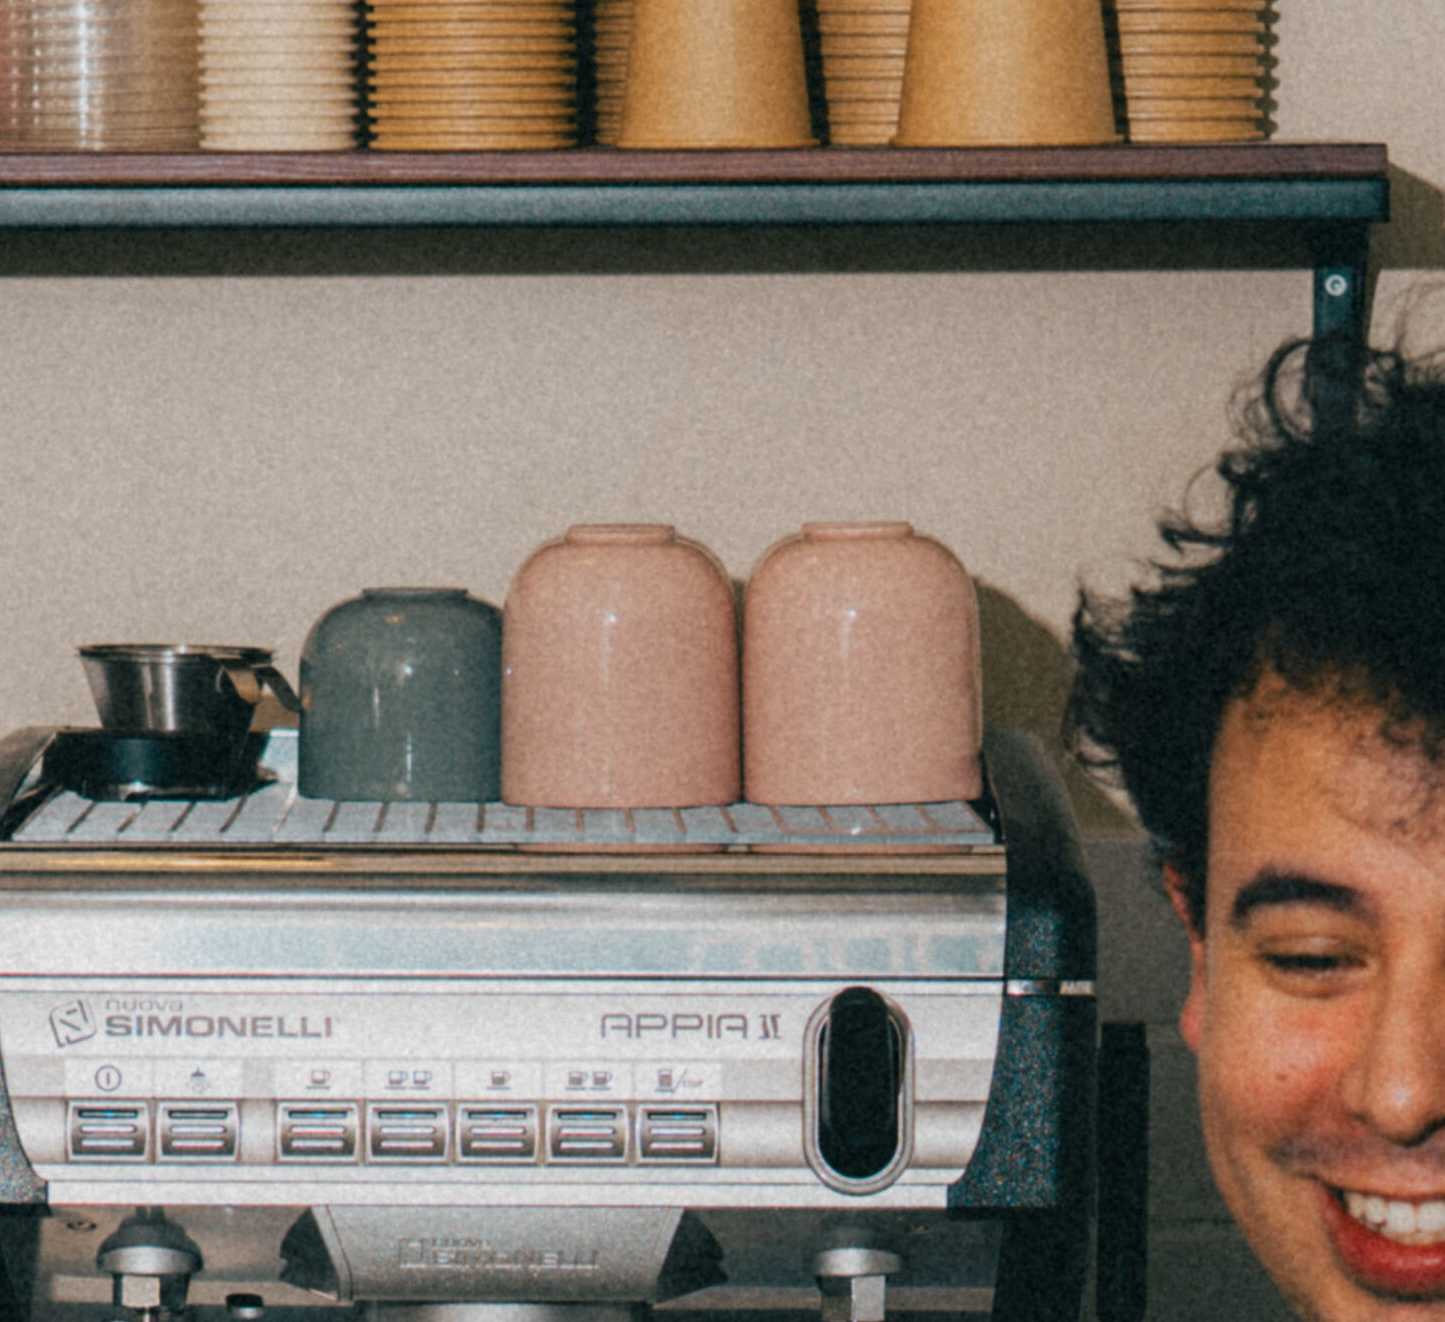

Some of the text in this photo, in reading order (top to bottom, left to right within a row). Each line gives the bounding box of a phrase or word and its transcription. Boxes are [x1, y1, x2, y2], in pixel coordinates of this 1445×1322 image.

[105, 998, 184, 1013] nuova
[105, 1014, 332, 1038] SIMONELLI
[600, 1013, 748, 1039] APPIA
